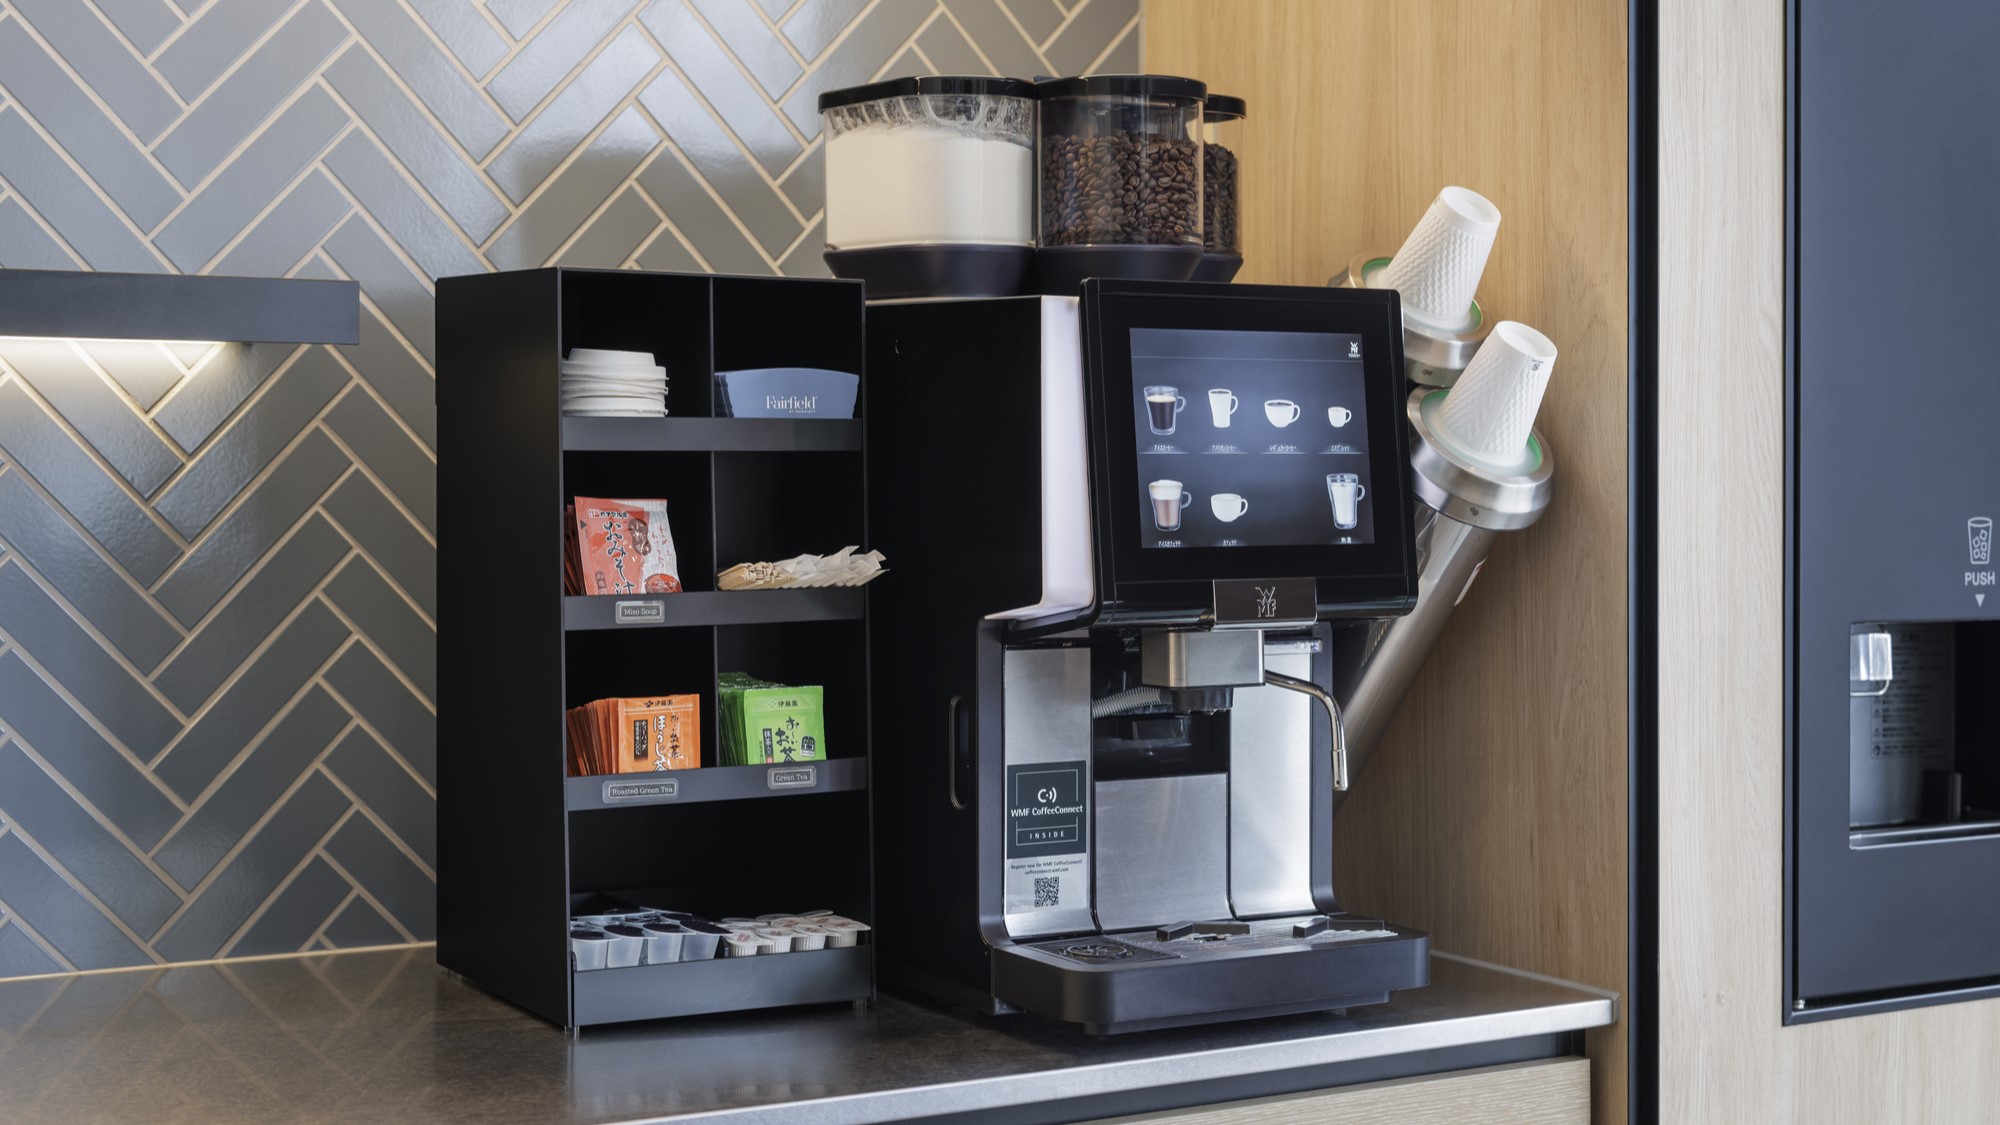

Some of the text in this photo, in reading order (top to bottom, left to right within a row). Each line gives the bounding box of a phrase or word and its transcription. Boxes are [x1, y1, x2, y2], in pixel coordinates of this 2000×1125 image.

[766, 395, 816, 410] Fairfield
[1964, 571, 1995, 586] PUSH
[624, 608, 658, 617] Miso Soup
[776, 774, 795, 782] Green
[612, 786, 673, 796] Roasted Green Tea
[1010, 804, 1083, 818] WMF CoffeeConnect
[1029, 830, 1065, 840] INSIDE
